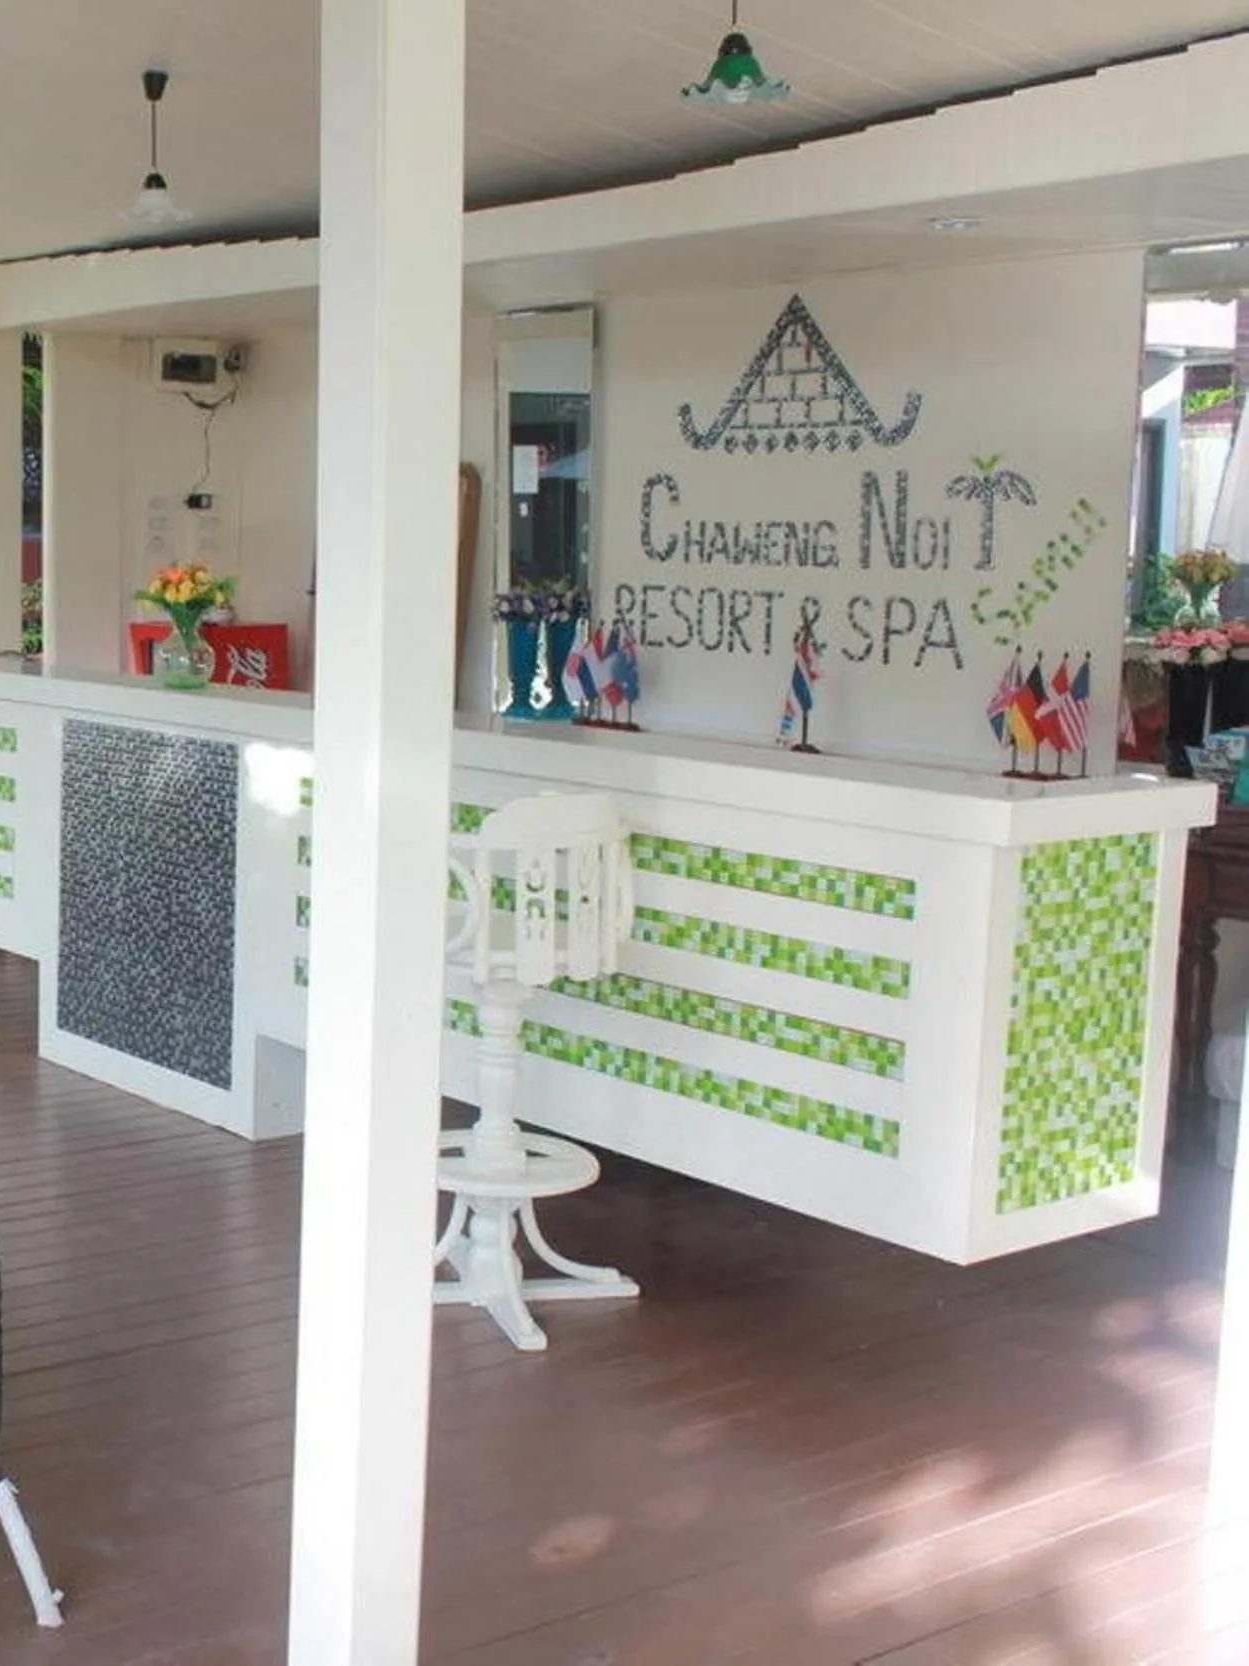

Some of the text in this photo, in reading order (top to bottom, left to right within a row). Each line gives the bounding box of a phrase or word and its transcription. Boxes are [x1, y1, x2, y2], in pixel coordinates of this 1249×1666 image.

[639, 470, 950, 570] CHAWENG NOI
[614, 584, 964, 670] RESORT & SPA
